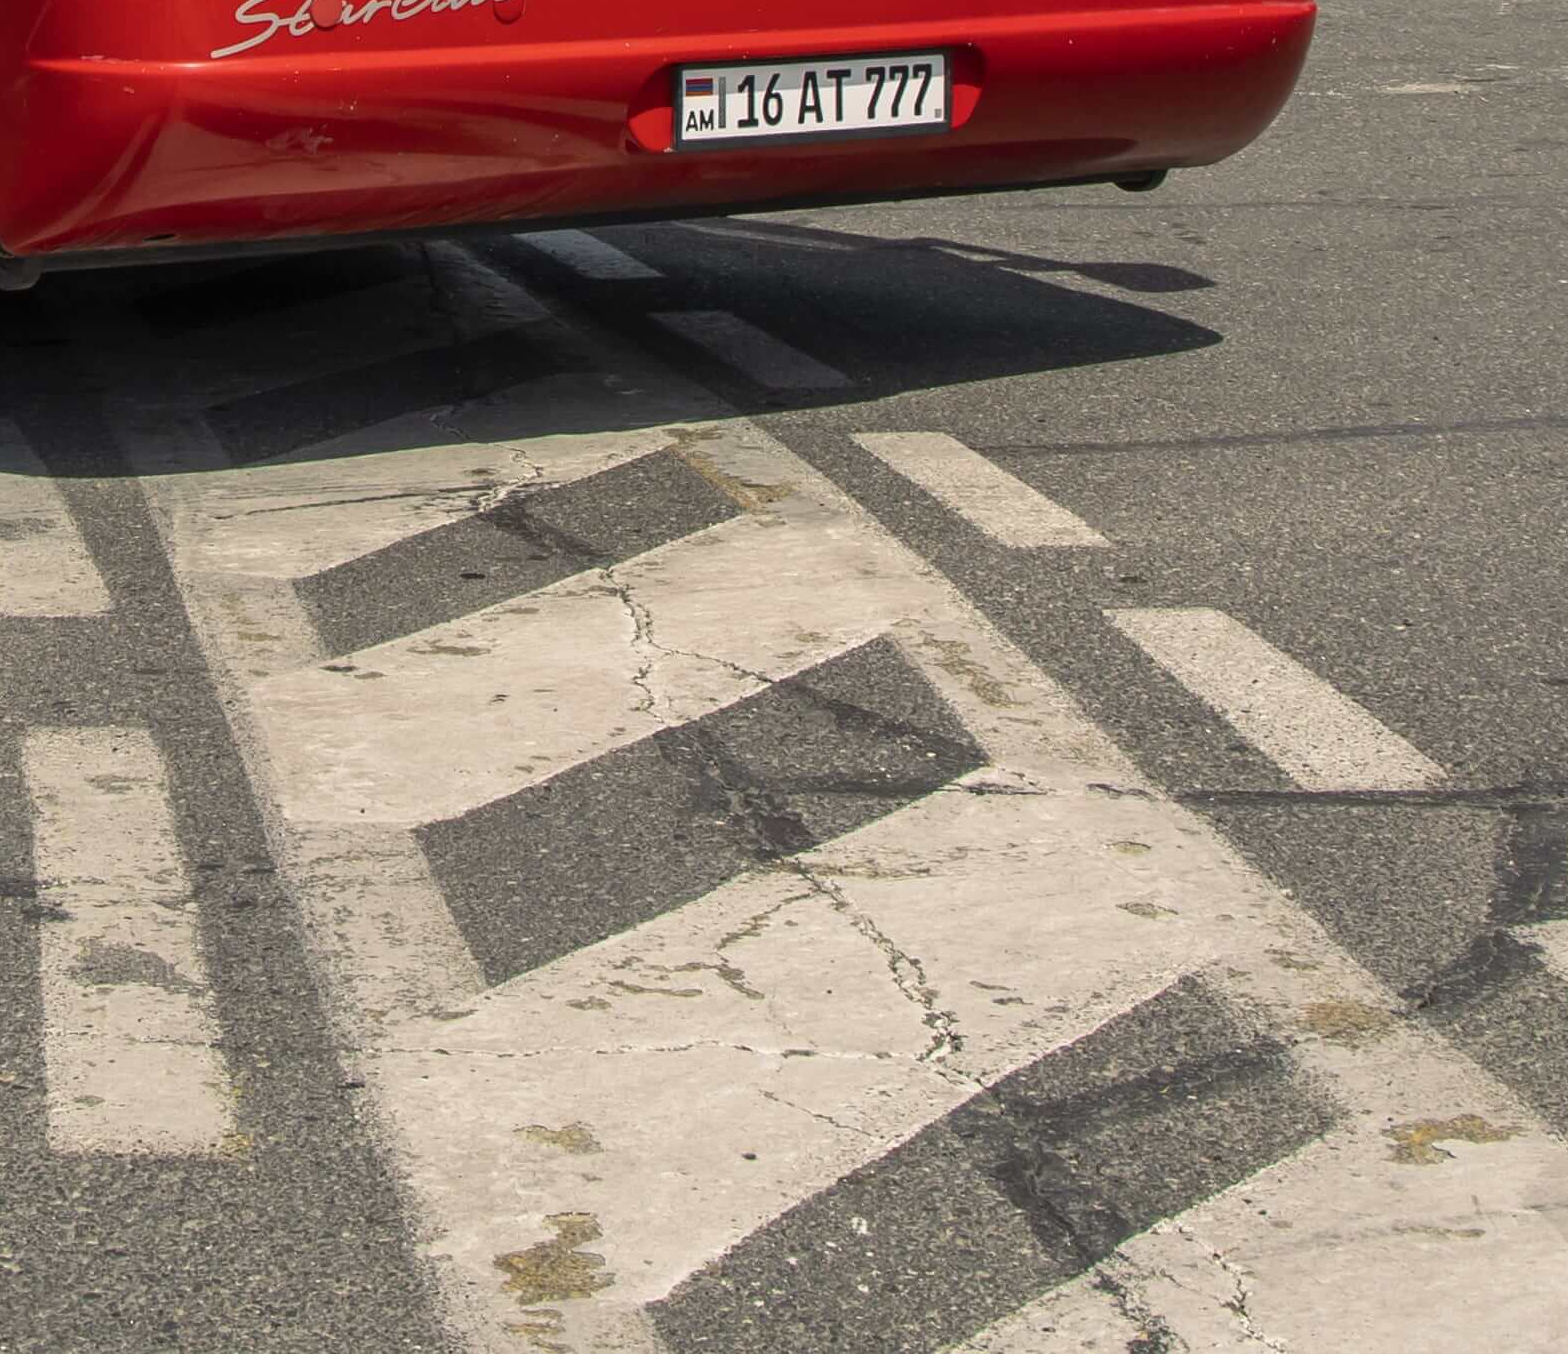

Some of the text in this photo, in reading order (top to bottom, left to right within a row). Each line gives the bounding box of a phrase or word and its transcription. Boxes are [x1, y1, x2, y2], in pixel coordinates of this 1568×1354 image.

[737, 63, 932, 129] 16 AT 777
[685, 109, 714, 132] AM
